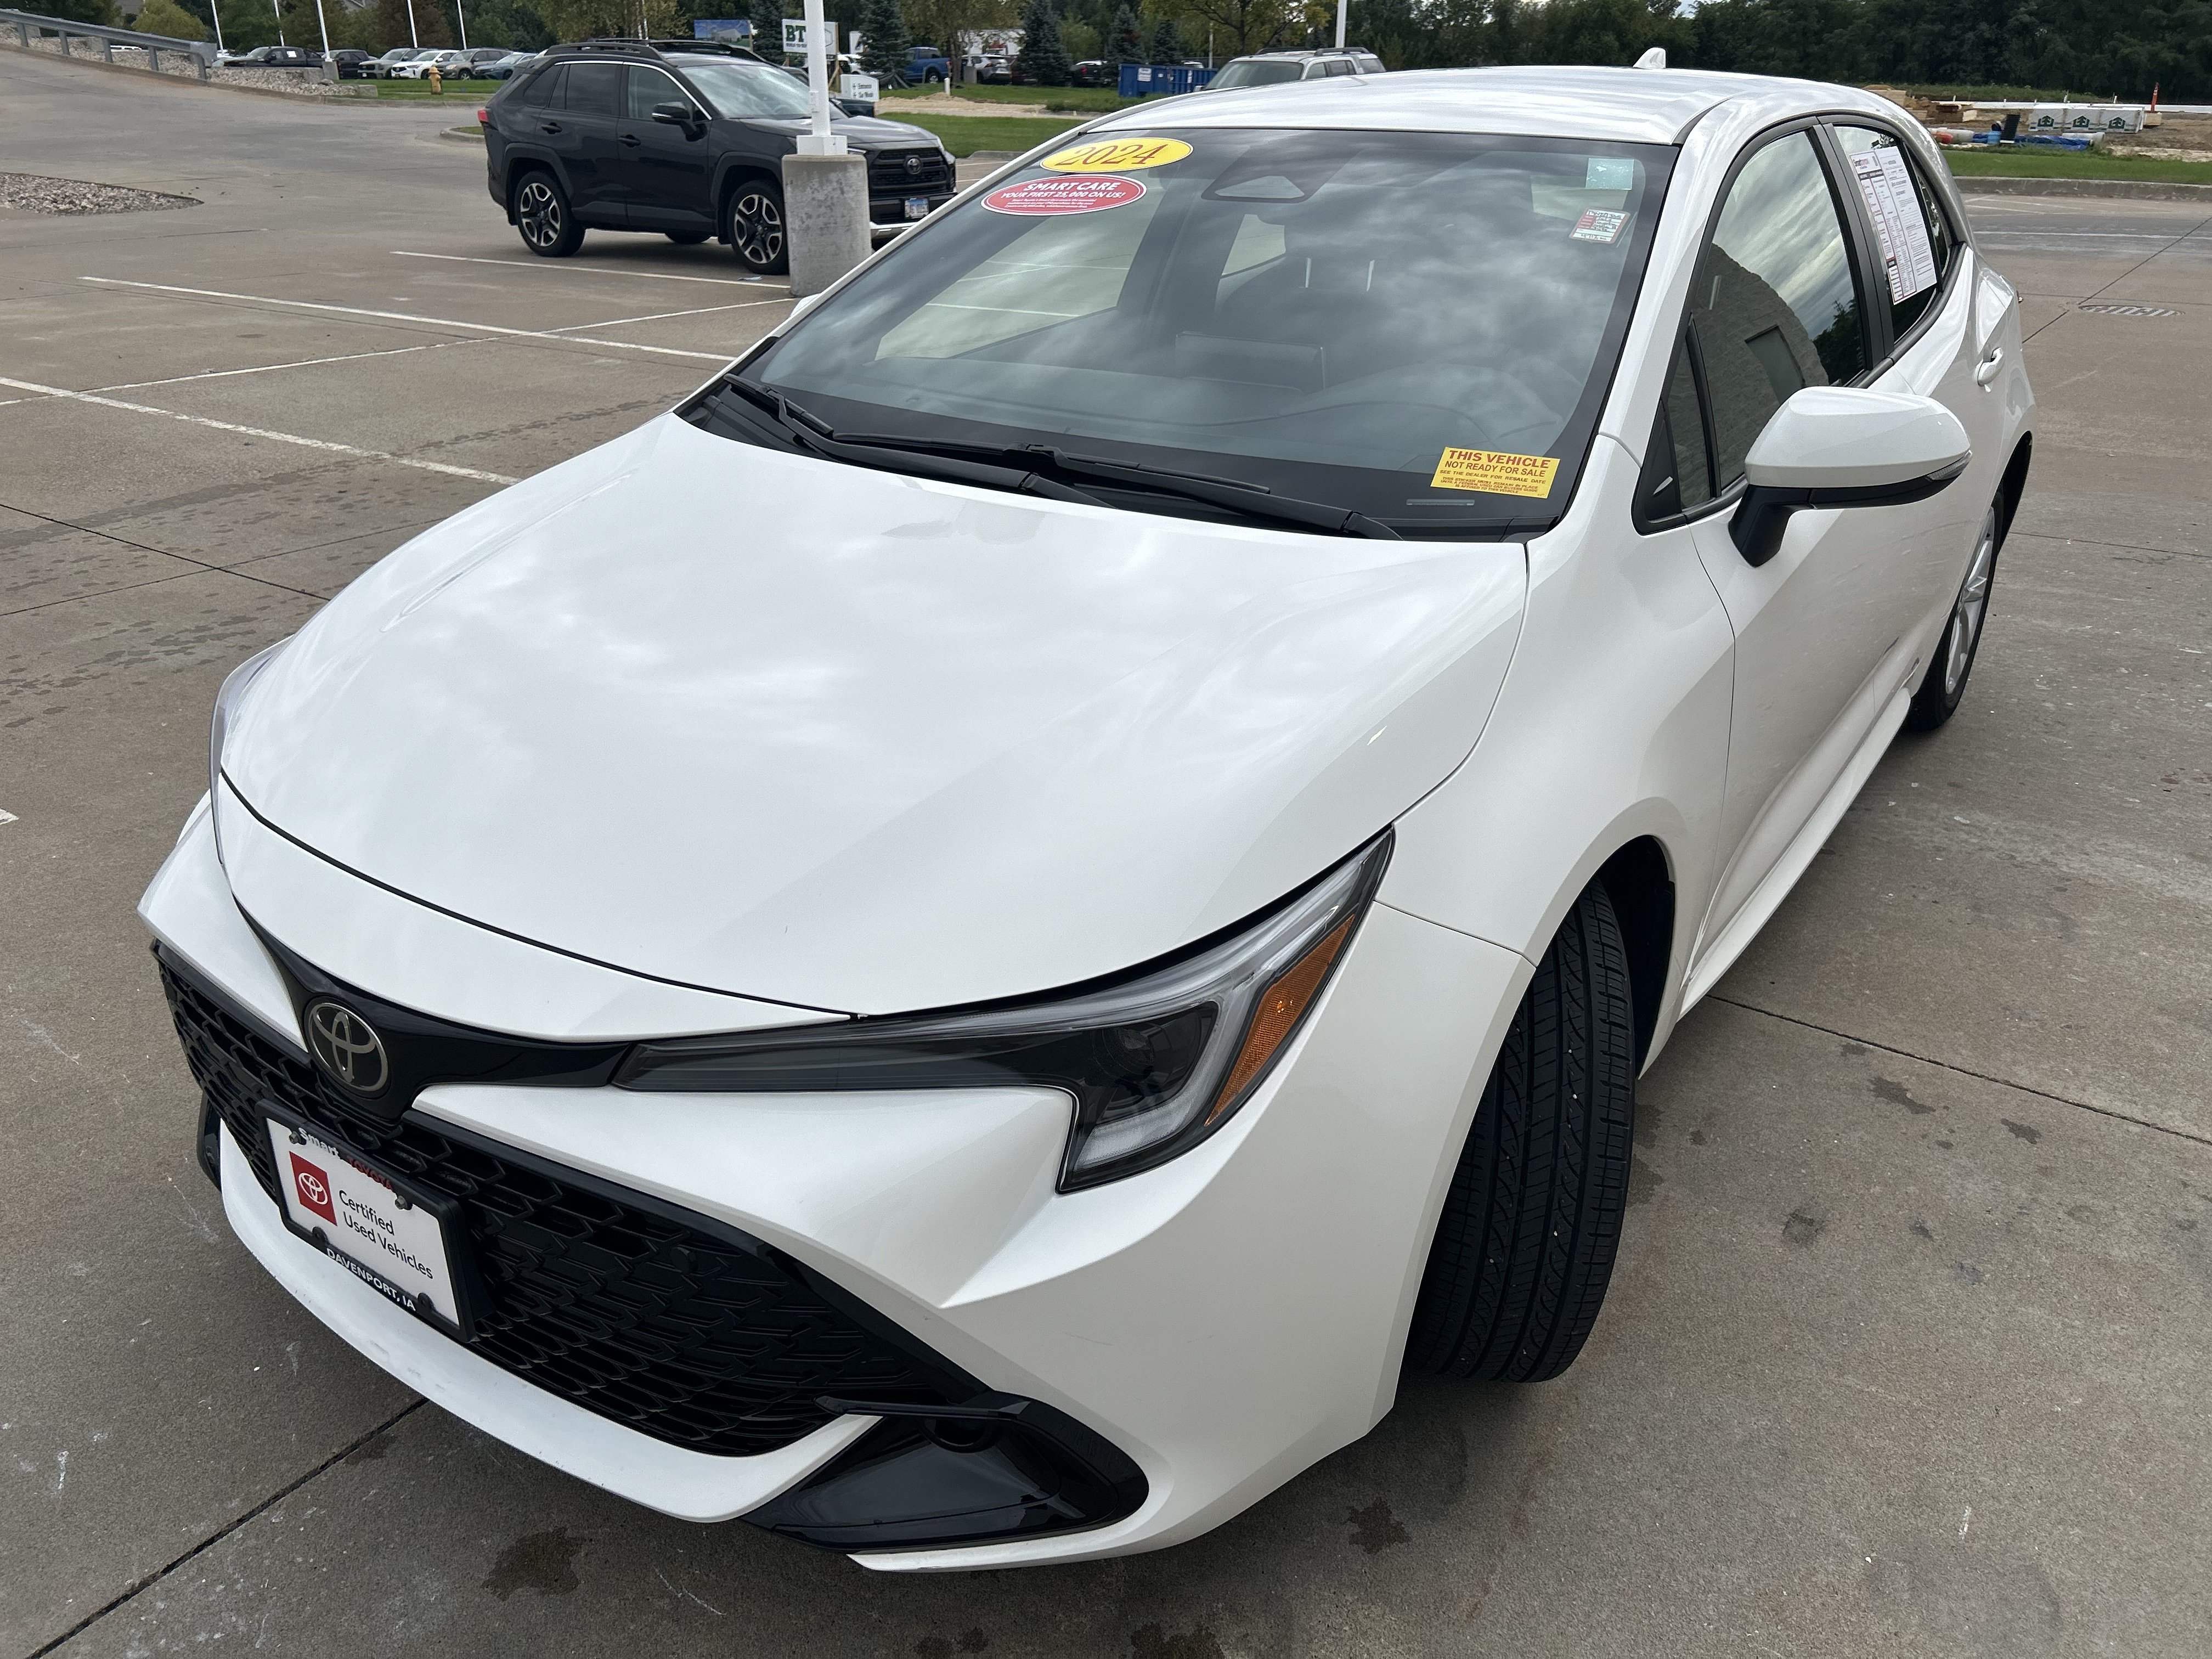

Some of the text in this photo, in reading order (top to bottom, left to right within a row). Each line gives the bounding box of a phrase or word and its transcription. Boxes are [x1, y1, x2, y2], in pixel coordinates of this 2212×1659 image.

[1055, 144, 1169, 166] 2024
[1023, 182, 1121, 191] SMART CARE
[1444, 460, 1546, 477] NOT READY FOR SALE
[1449, 450, 1551, 469] THIS VEHICLE
[298, 1127, 393, 1190] Smart TOYOTA
[339, 1189, 394, 1235] Certified
[343, 1211, 434, 1280] Used Vehicles
[326, 1248, 416, 1311] DAVENPORT, IA
